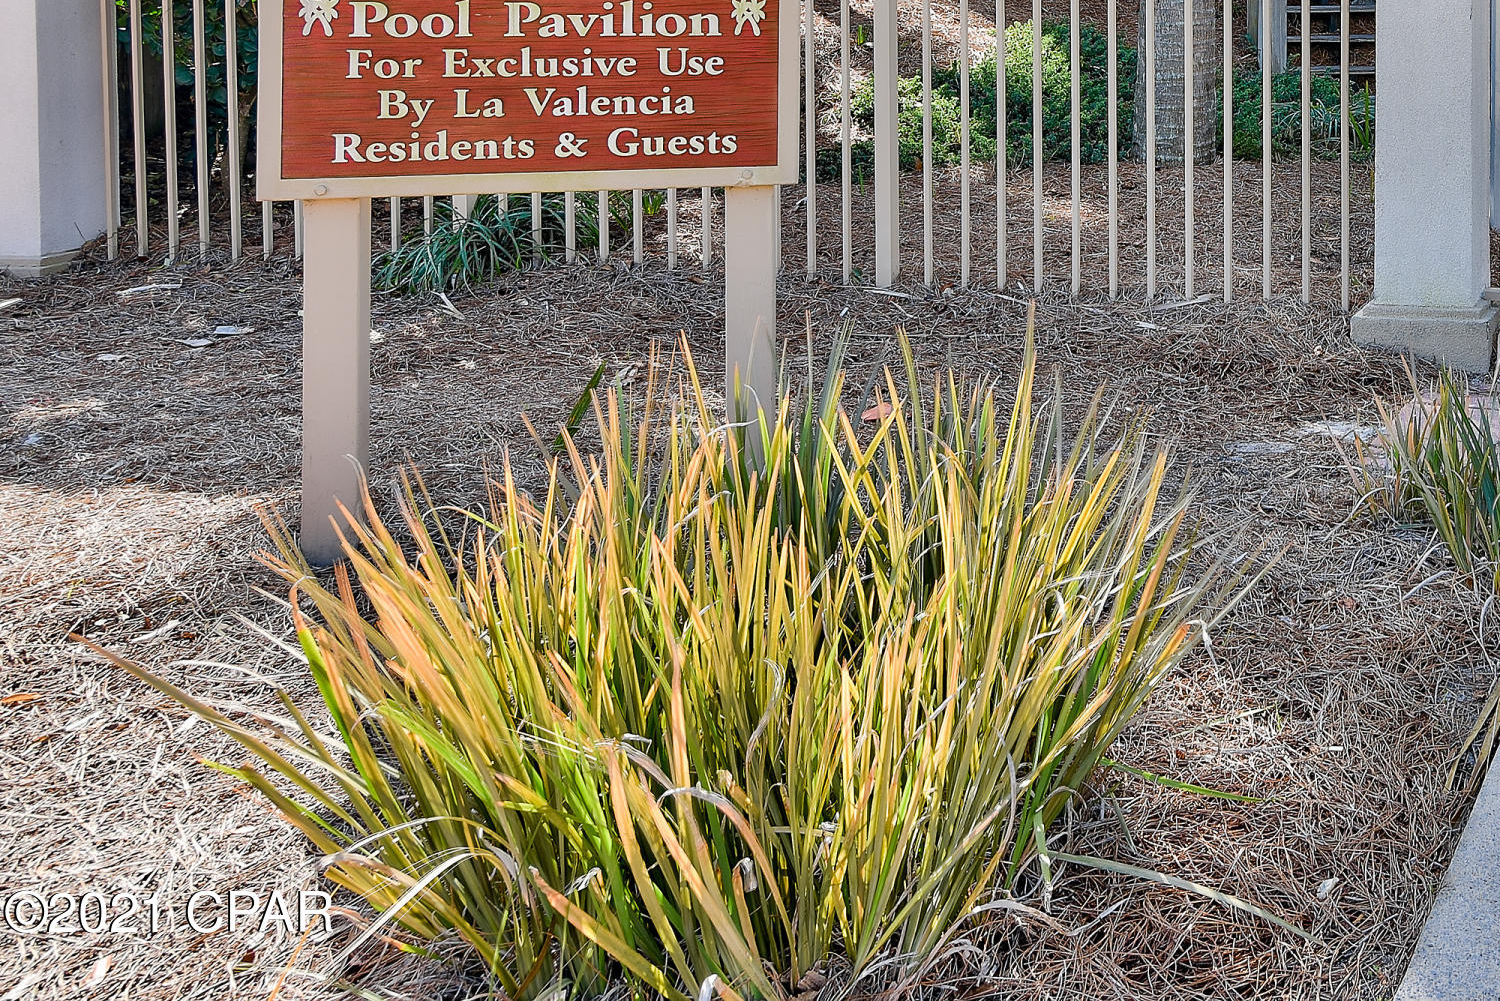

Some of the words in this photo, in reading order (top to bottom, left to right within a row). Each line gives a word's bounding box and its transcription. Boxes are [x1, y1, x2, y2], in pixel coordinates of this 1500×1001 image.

[348, 0, 474, 39] Pool
[503, 0, 724, 38] Pavilion
[345, 48, 423, 80] For
[441, 46, 638, 79] Exclusive
[656, 47, 725, 77] Use
[376, 89, 436, 128] By
[453, 89, 507, 119] La
[523, 85, 697, 118] Valencia
[331, 129, 536, 165] Residents
[553, 131, 589, 159] &
[607, 127, 739, 158] Guests
